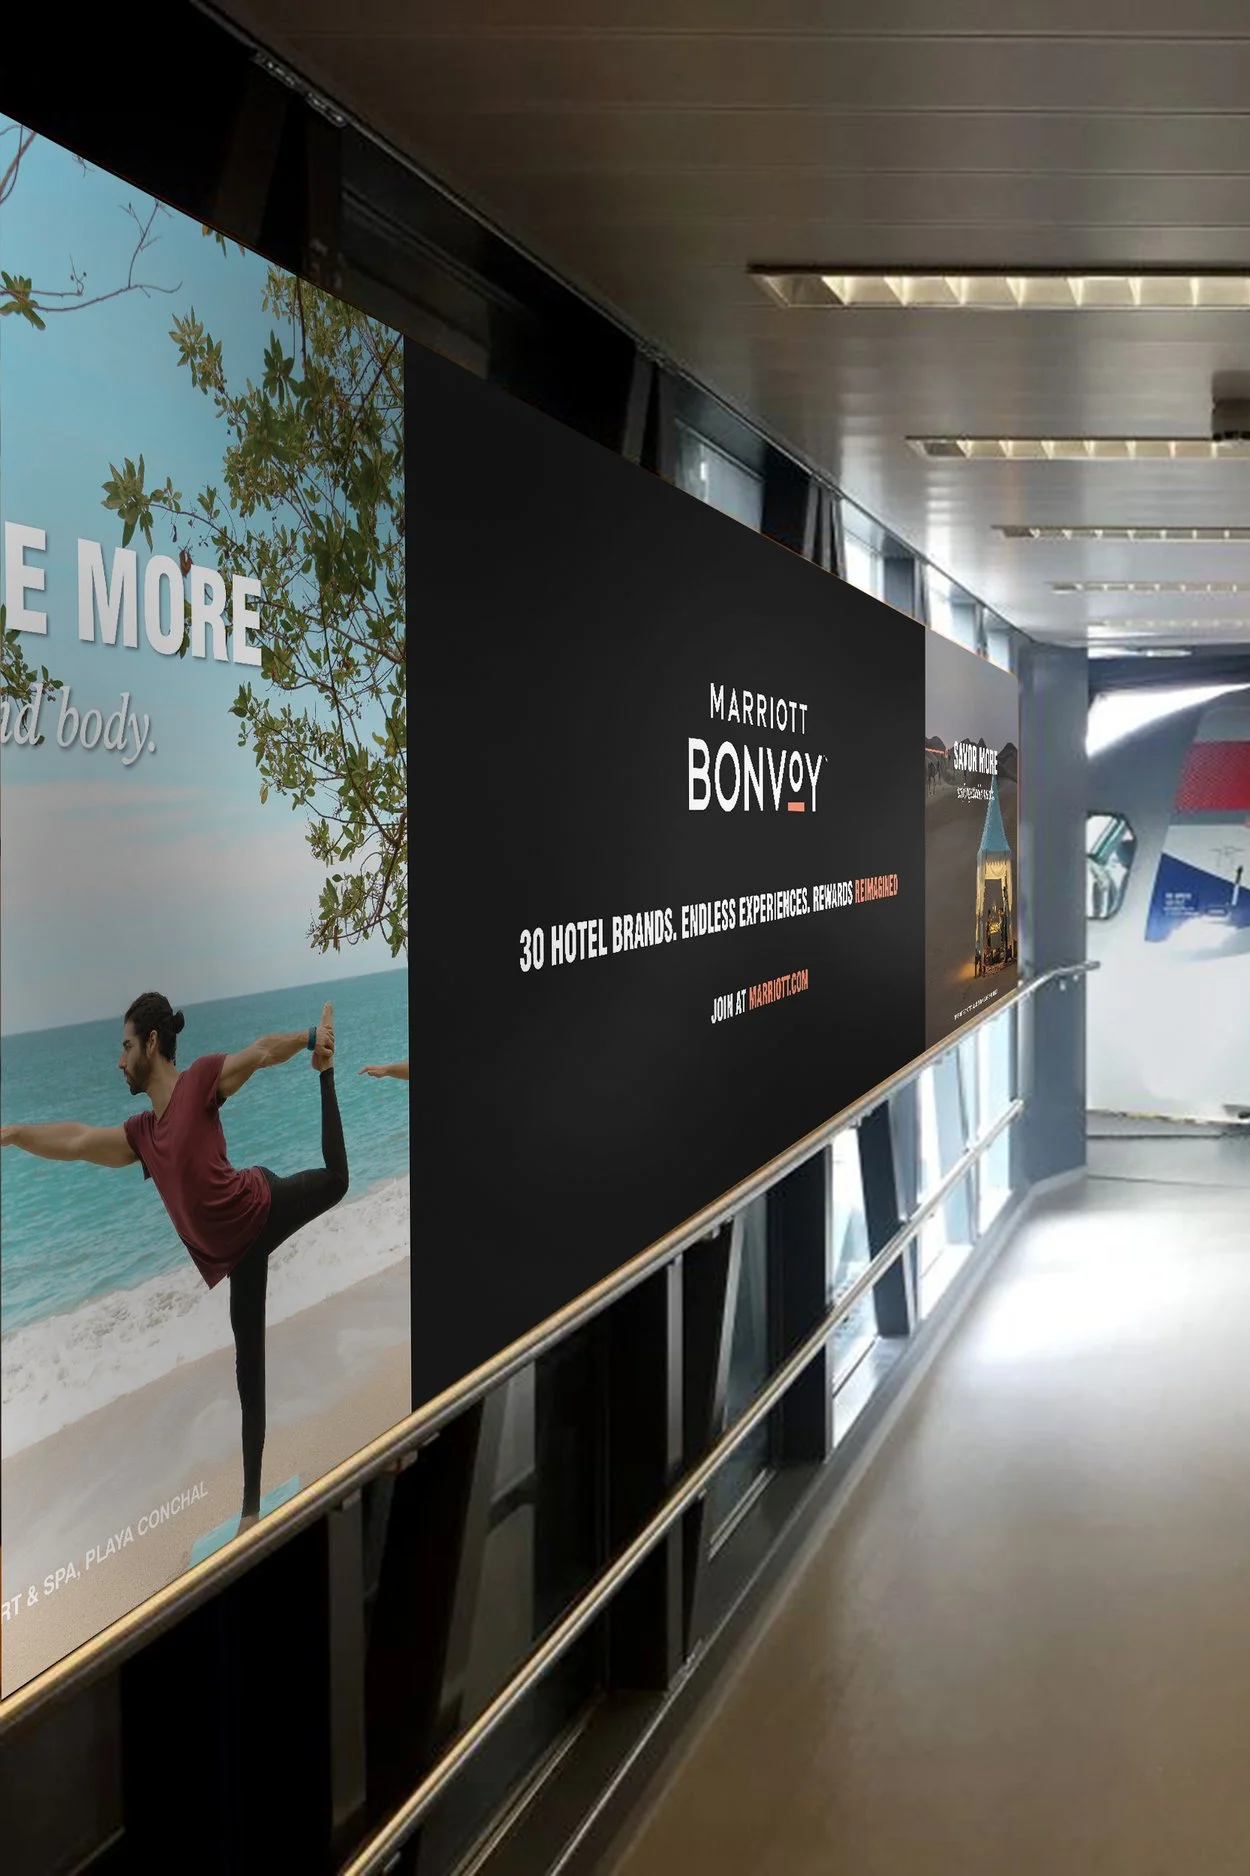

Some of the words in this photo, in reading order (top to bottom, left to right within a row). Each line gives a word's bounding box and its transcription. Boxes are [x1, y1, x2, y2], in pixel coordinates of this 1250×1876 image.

[5, 521, 48, 634] E
[78, 538, 262, 666] MORE
[56, 685, 156, 767] body.
[710, 682, 808, 734] MARRIOTT
[688, 738, 823, 812] BONVOY
[953, 740, 978, 772] SAVOR
[979, 746, 998, 775] MORE
[519, 928, 545, 972] 30
[551, 918, 608, 966] HOTEL
[612, 907, 677, 954] BRANDS.
[682, 898, 736, 940] ENDLESS
[739, 887, 811, 927] EXPERIENCES.
[813, 880, 853, 913] REWARDS
[855, 873, 899, 904] REIMAGINED
[711, 993, 734, 1024] JOIN
[735, 988, 747, 1016] AT
[749, 969, 809, 1010] MARRIOTT.COM
[27, 1584, 39, 1606] &
[44, 1562, 81, 1596] SPA,
[86, 1526, 134, 1570] PLAYA
[138, 1481, 209, 1536] CONCHAL
